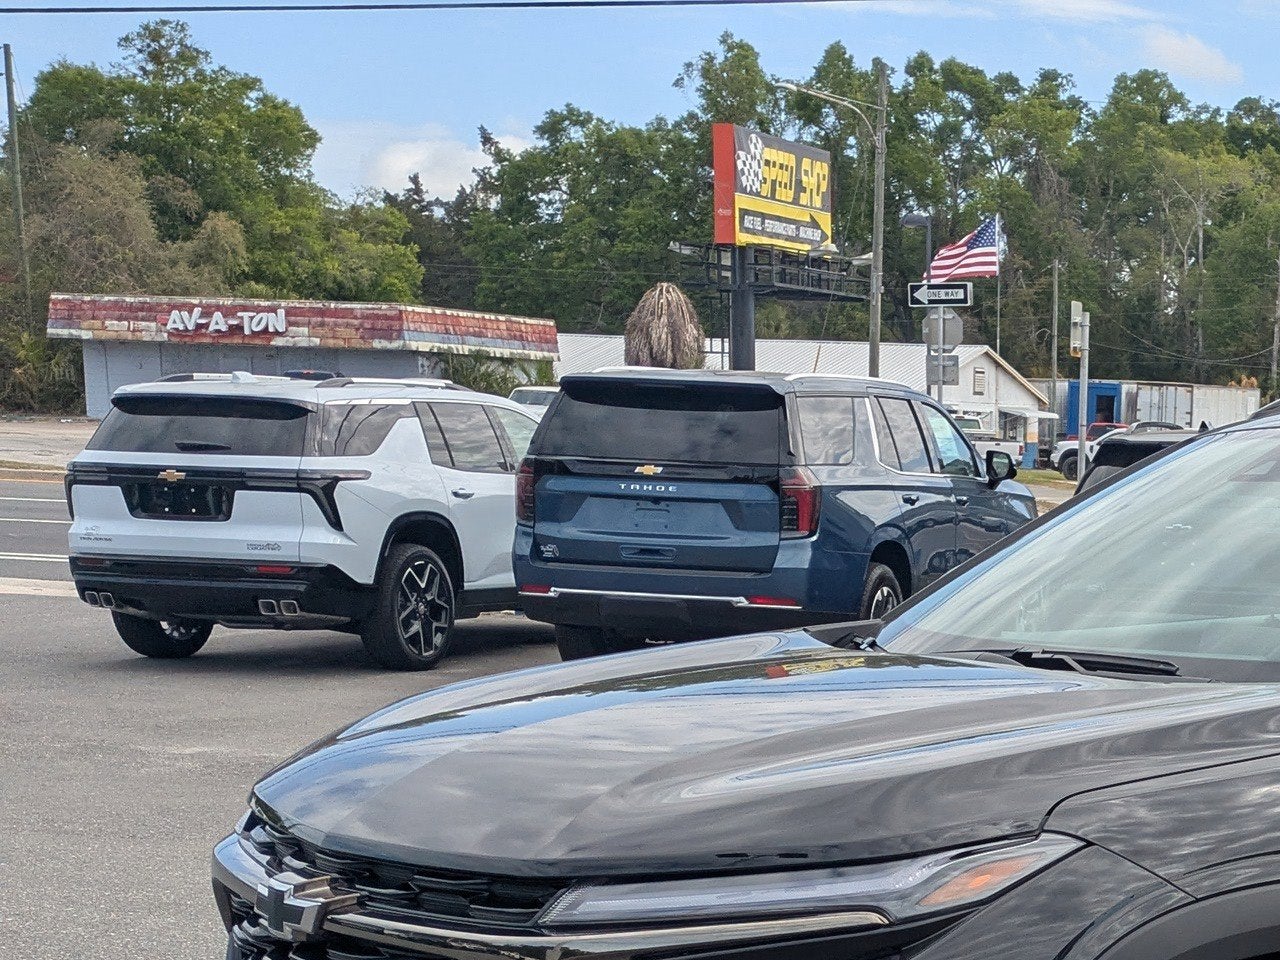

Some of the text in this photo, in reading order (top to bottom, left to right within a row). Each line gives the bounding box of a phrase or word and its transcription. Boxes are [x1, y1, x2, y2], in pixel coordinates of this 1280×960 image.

[761, 147, 829, 209] SPEED SHOP
[926, 290, 959, 299] ONE WAY
[166, 307, 286, 335] AV-A-TON
[619, 483, 678, 493] TAHOE
